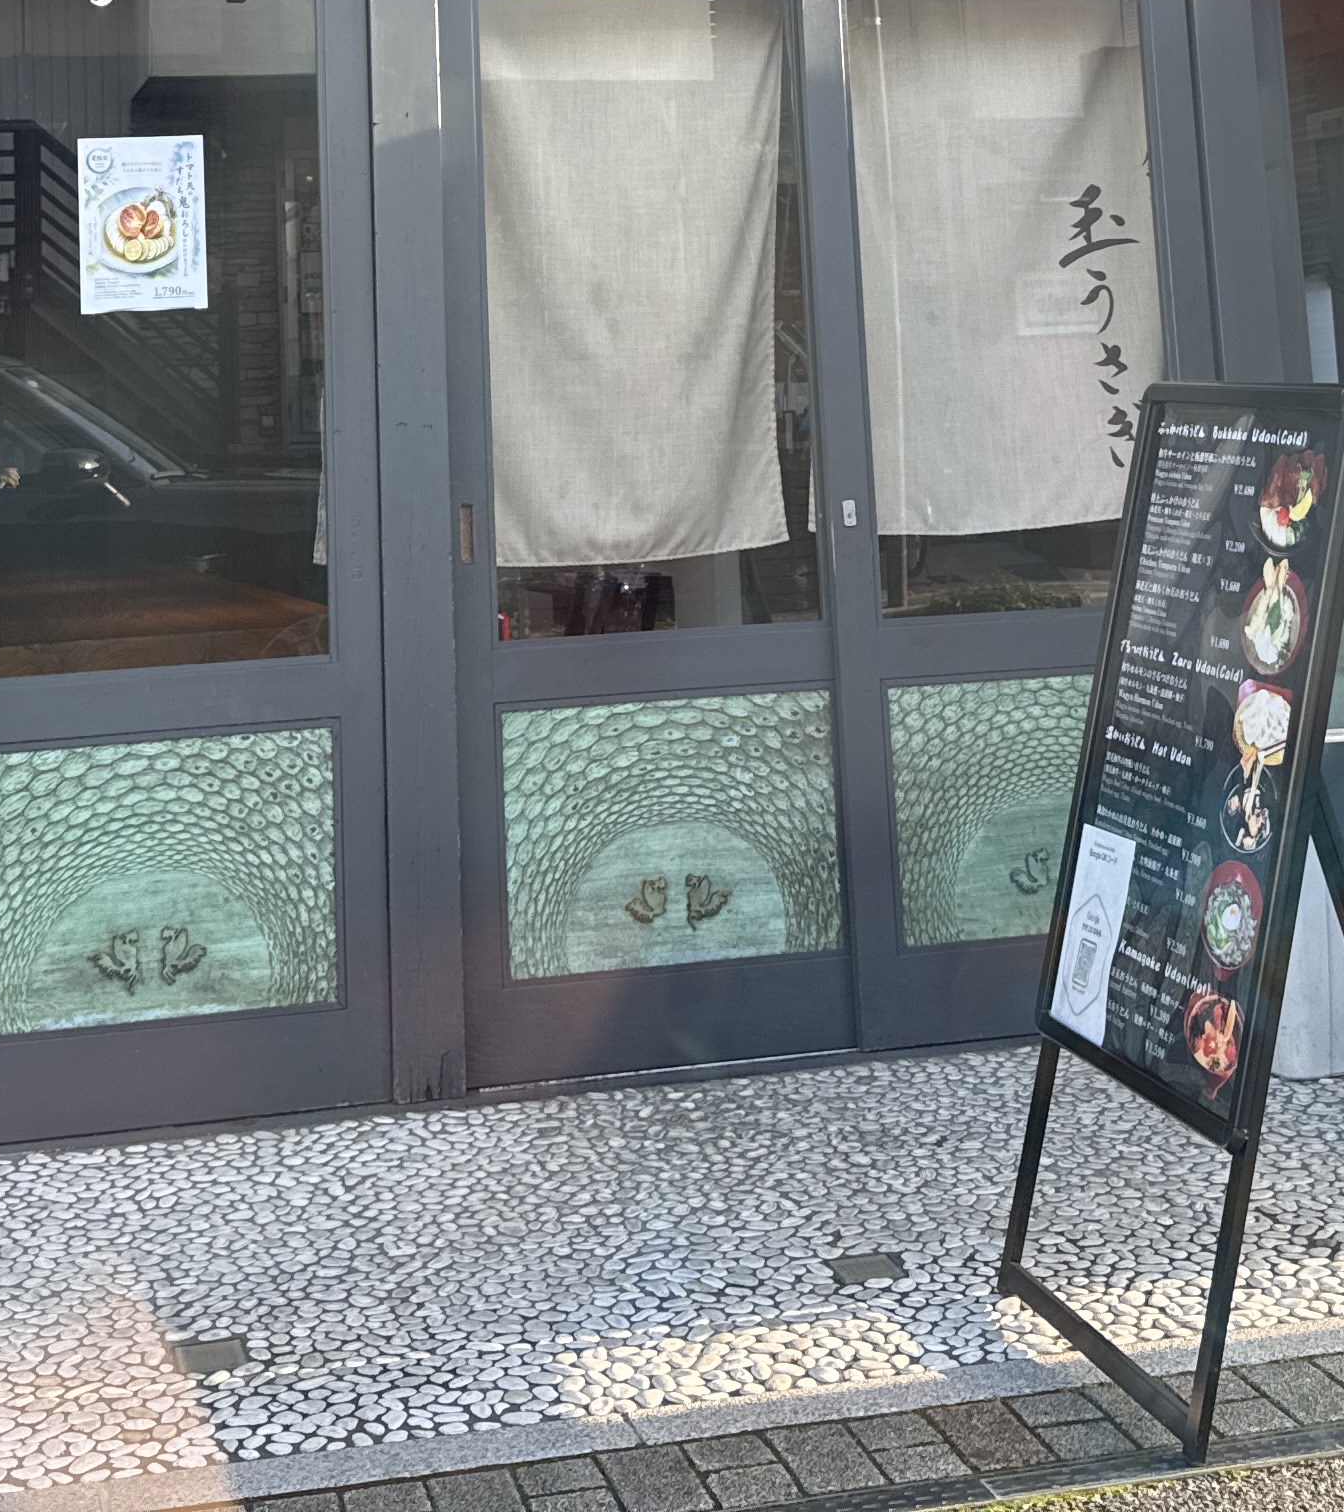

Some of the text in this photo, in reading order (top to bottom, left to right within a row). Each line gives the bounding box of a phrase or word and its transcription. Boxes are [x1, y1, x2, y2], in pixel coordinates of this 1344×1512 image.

[1212, 425, 1248, 441] Bukkake
[1251, 427, 1308, 448] Udon(Cold)
[1195, 658, 1244, 685] Udon(Cold)
[1151, 740, 1168, 758] Hot
[1170, 745, 1192, 767] Udon
